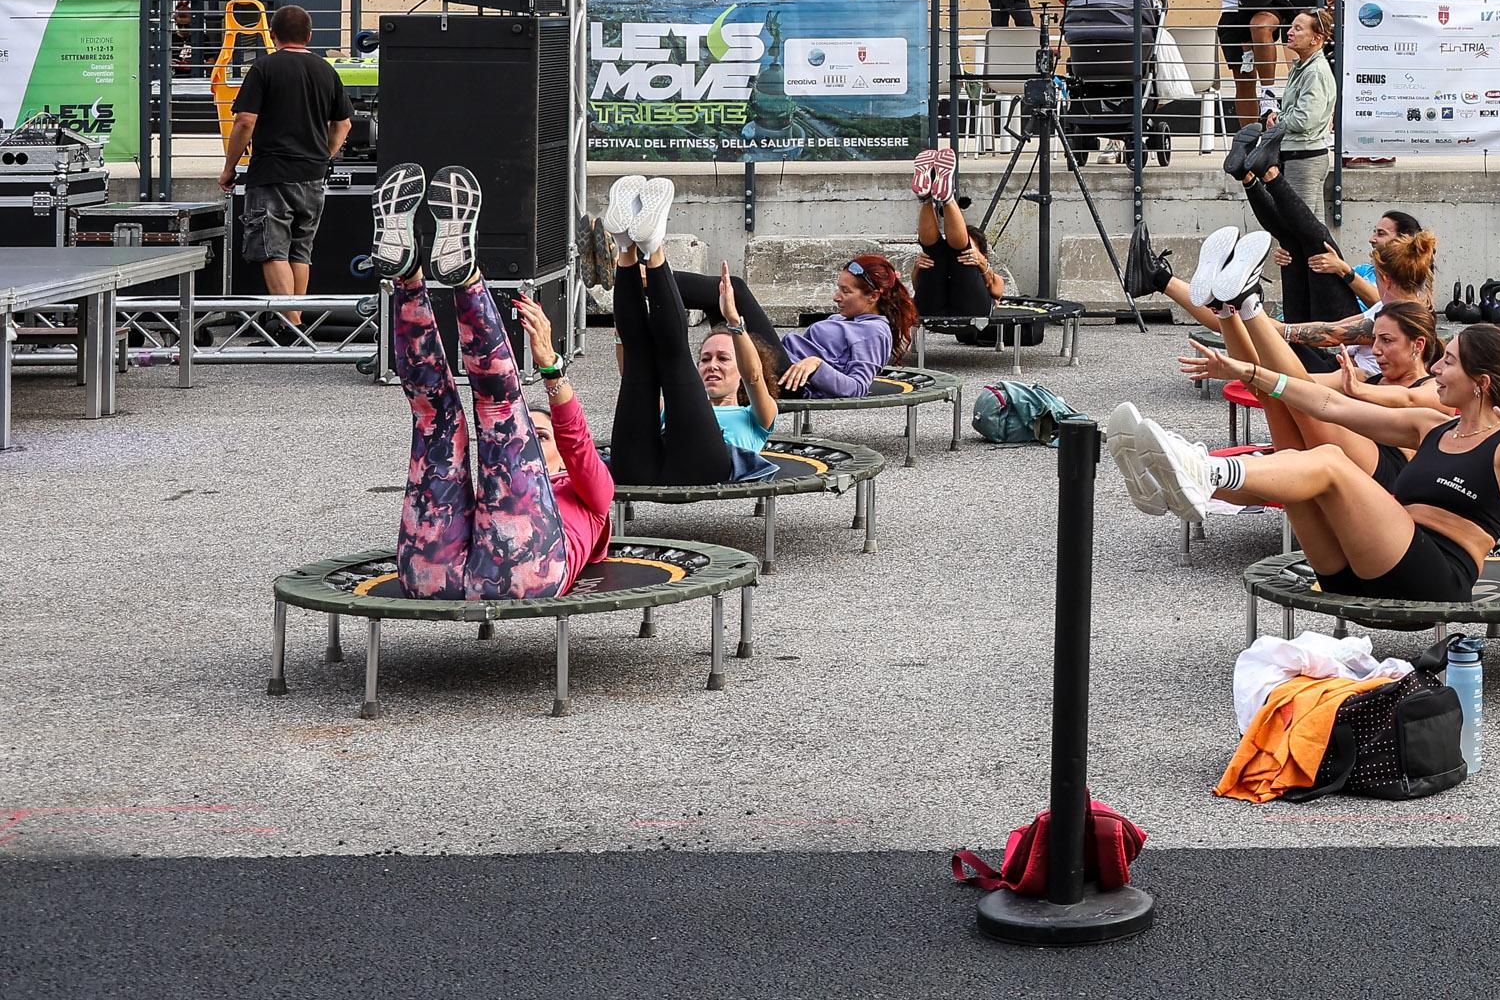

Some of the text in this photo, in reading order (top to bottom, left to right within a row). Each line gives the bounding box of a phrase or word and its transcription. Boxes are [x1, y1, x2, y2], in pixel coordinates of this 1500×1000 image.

[1357, 44, 1389, 52] creativa
[590, 62, 762, 100] MOVE
[1356, 74, 1386, 84] GENIUS
[591, 101, 748, 126] TRIESTE
[588, 136, 909, 150] FESTIVAL DEL FITNESS, DELLA SALUTE E DEL BENESSERE
